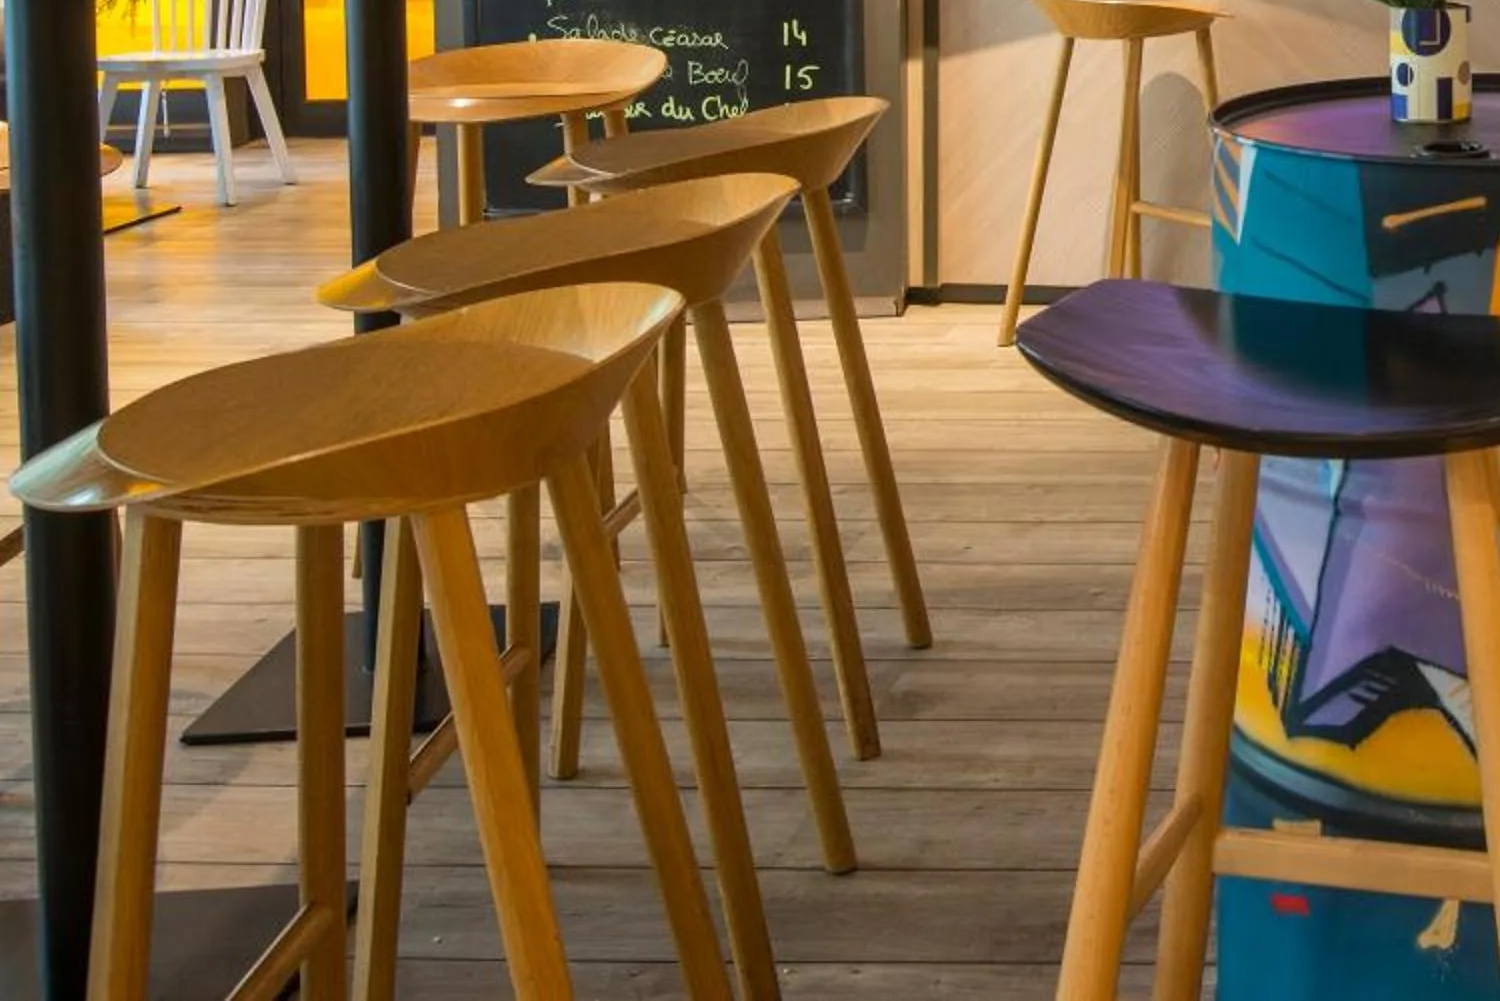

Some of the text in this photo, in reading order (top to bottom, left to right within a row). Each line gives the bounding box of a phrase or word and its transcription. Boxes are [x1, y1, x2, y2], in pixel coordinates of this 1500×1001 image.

[782, 18, 808, 46] 14
[784, 63, 821, 90] 15
[661, 95, 695, 121] du
